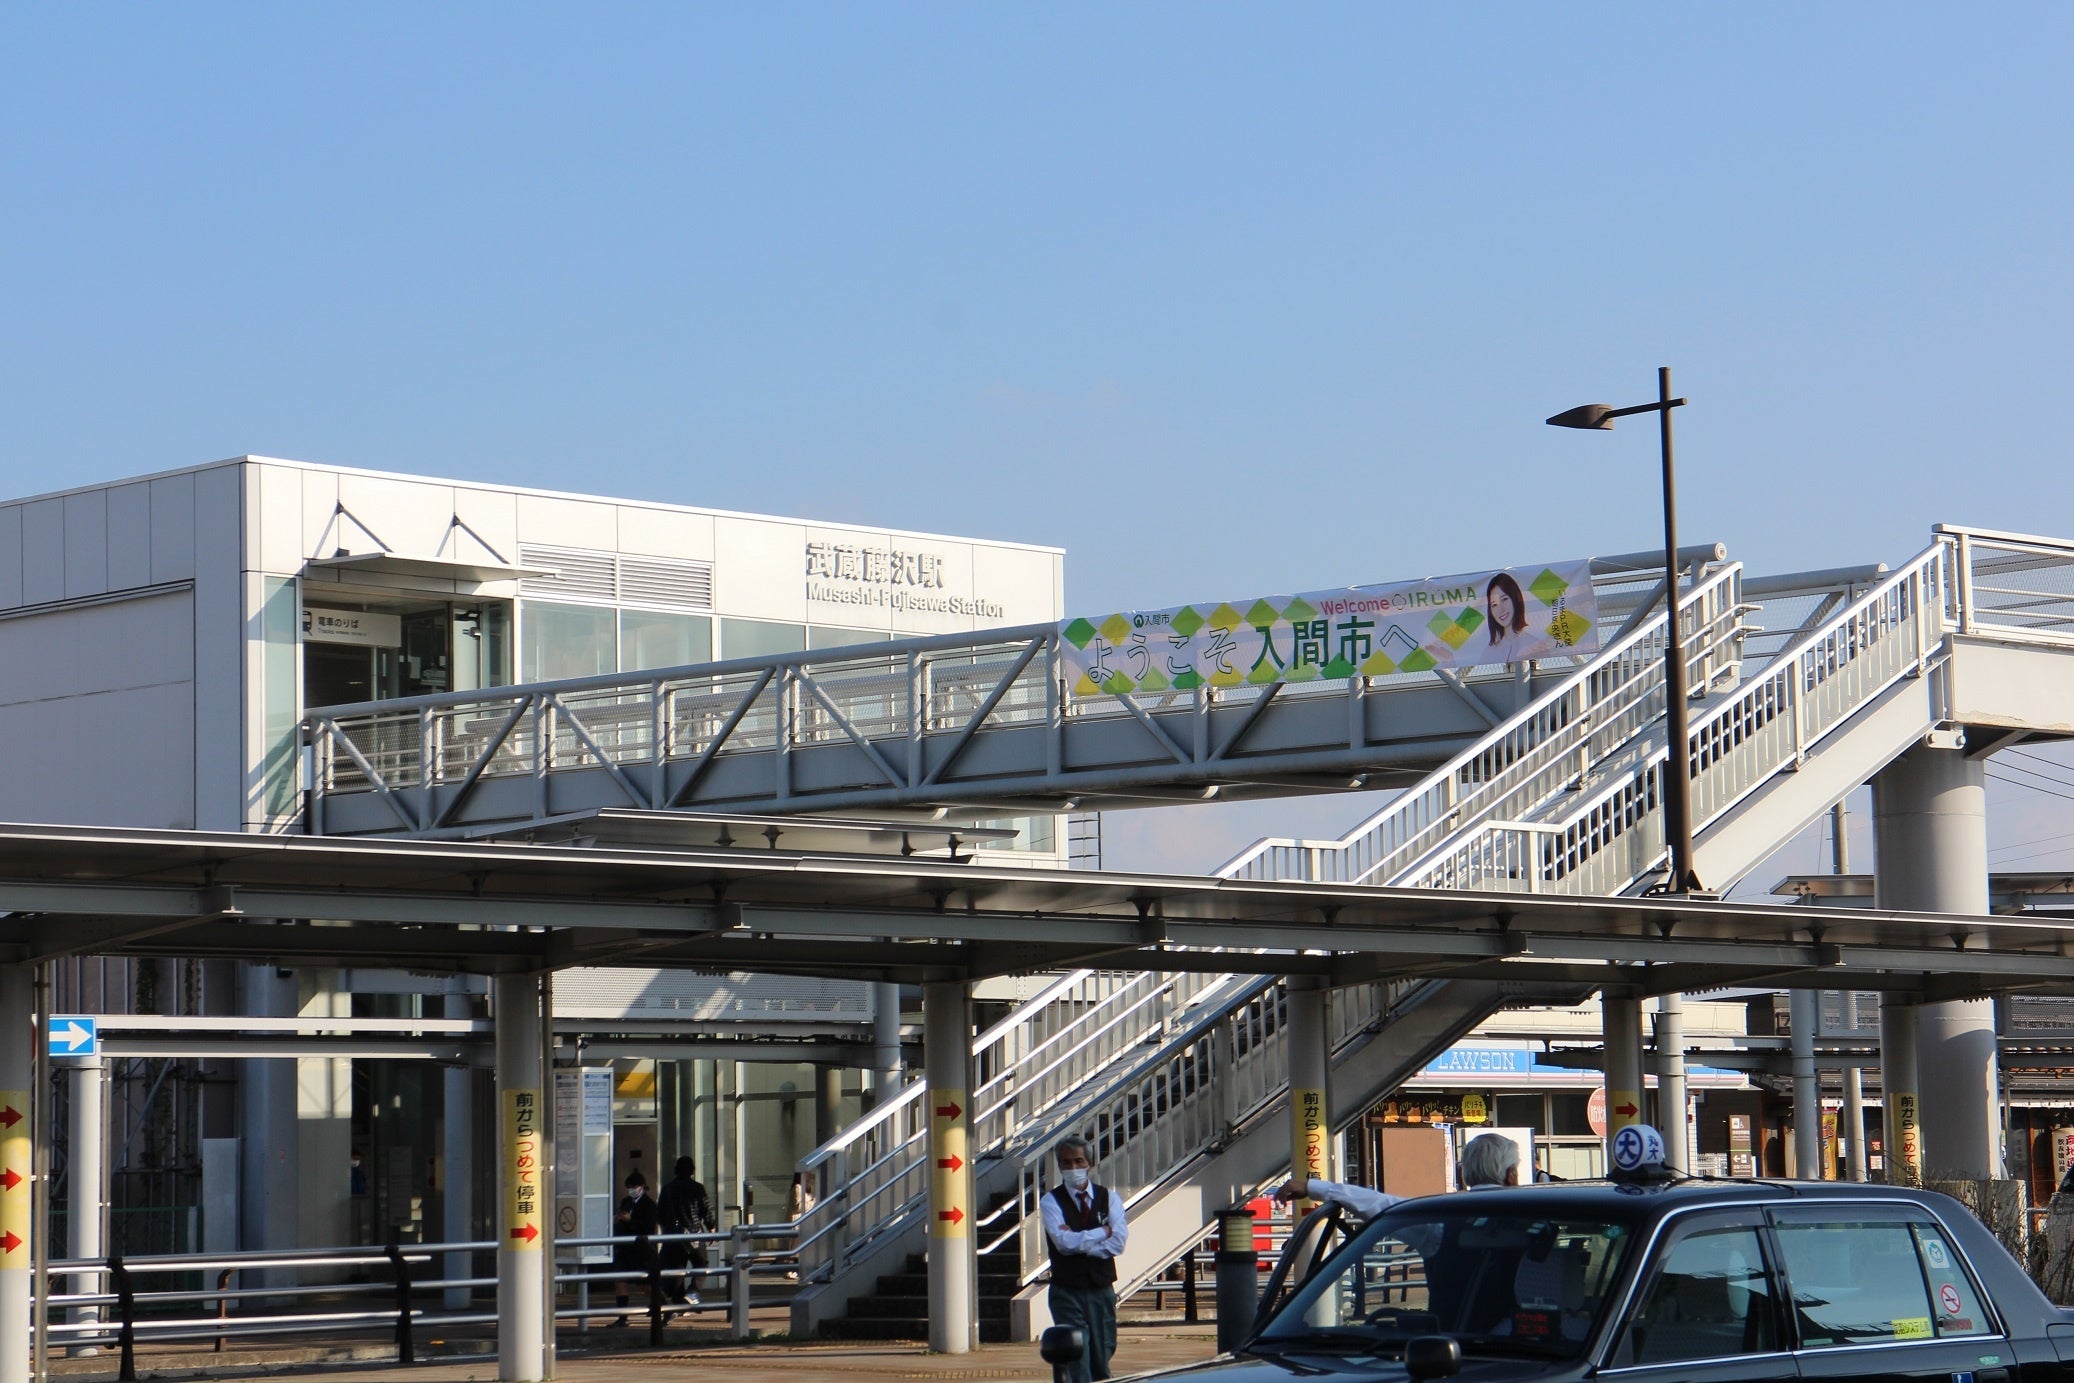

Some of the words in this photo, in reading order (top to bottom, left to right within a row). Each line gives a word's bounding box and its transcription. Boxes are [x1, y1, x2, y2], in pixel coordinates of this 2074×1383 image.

[806, 542, 945, 590] 武蔵藤沢駅
[806, 581, 946, 612] Musashi-Fujisawa
[949, 596, 1004, 618] Station
[1320, 598, 1390, 616] Welcome
[318, 616, 360, 629] 電車のりば
[1144, 613, 1170, 626] 入間市
[1438, 1051, 1516, 1070] LAWSON
[516, 1093, 535, 1214] 前からつめて停車
